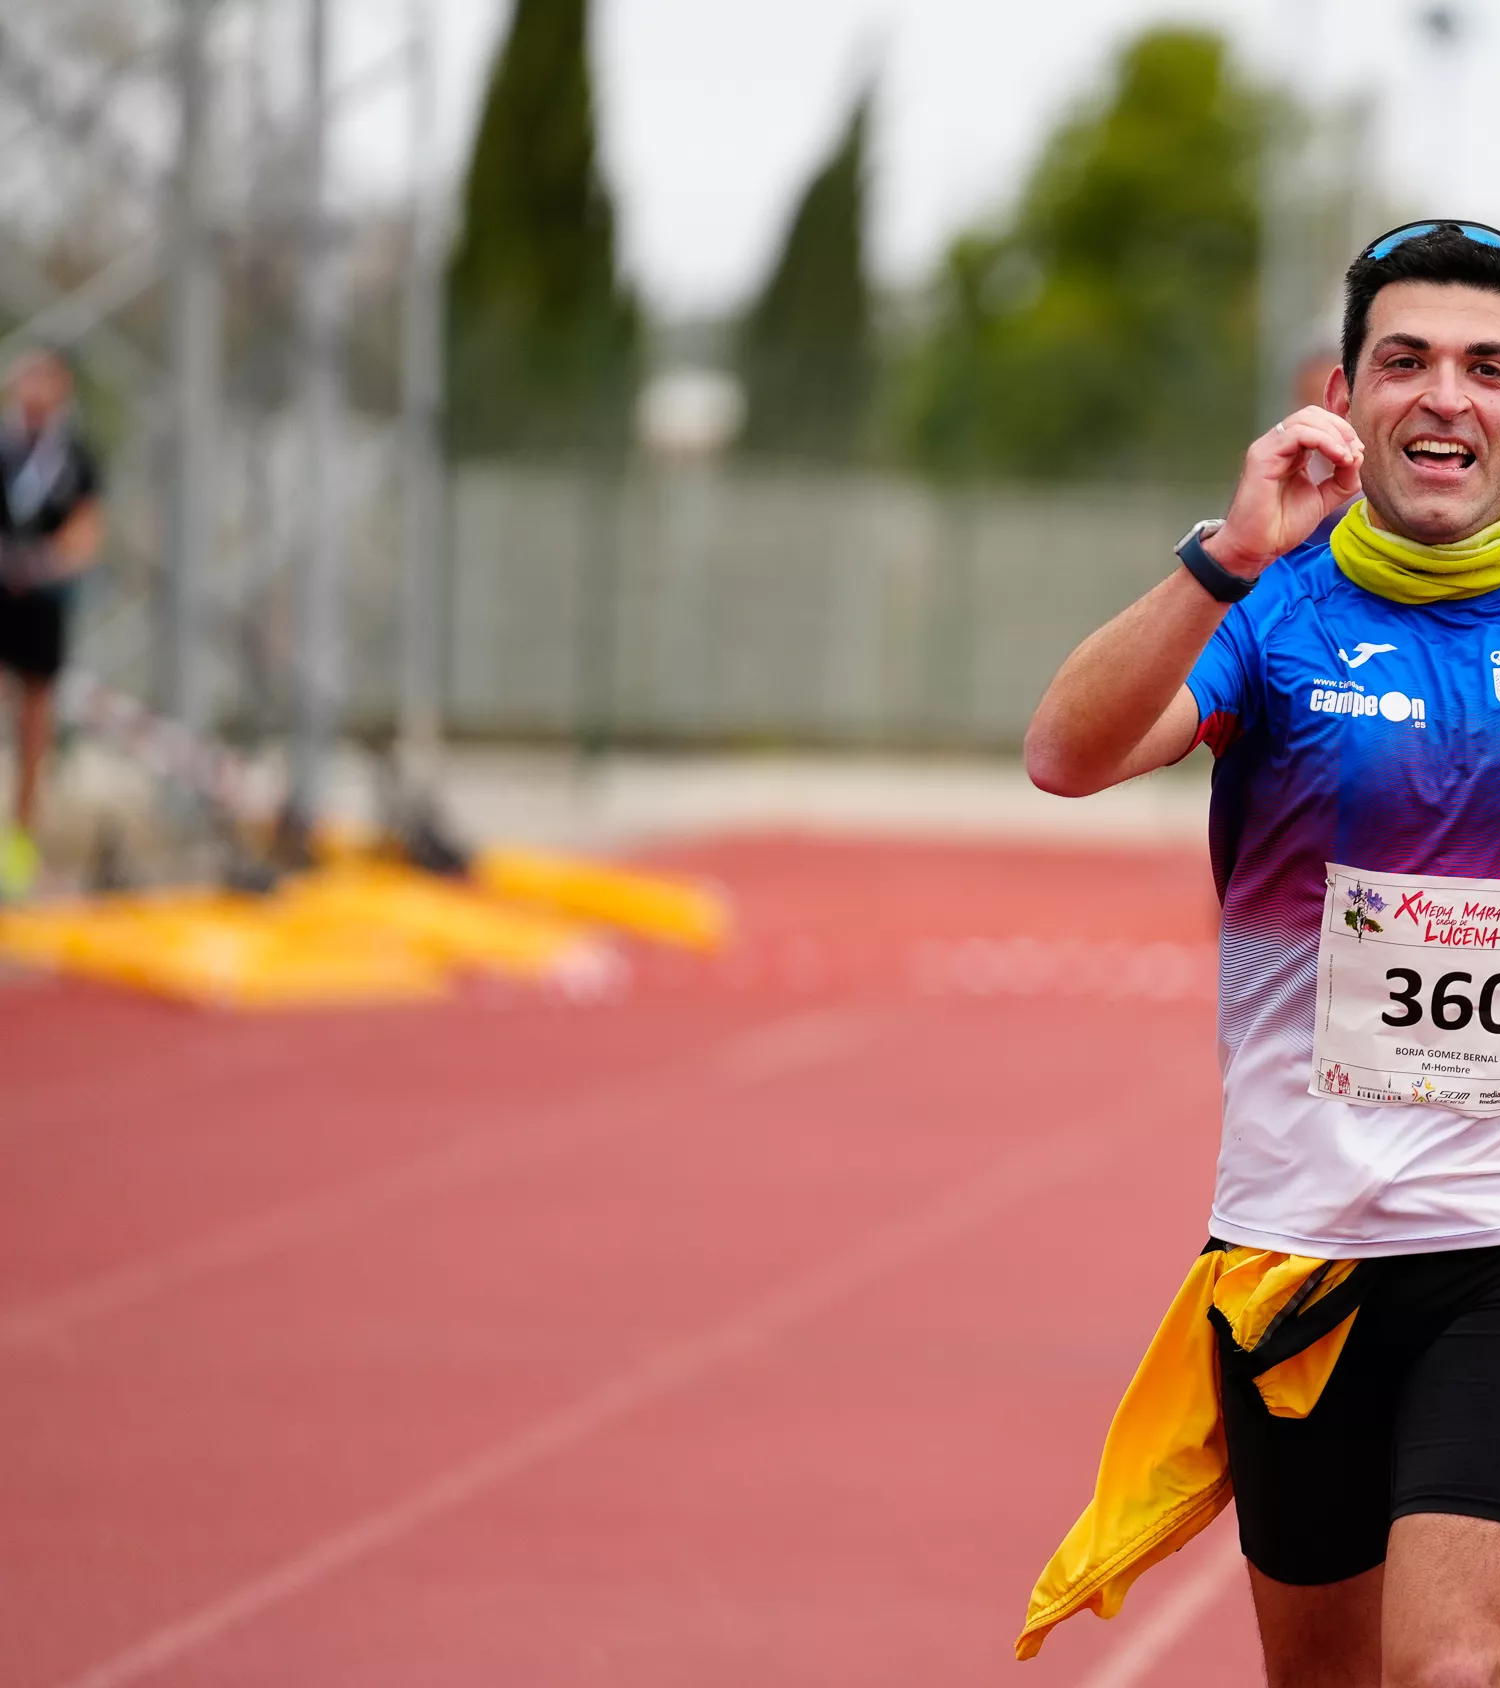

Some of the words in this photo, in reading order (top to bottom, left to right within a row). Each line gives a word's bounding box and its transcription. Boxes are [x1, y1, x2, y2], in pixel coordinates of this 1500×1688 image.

[1395, 1047, 1425, 1057] BORJA
[1427, 1049, 1461, 1060] GOMEZ
[1463, 1052, 1499, 1063] BERNAL
[1421, 1062, 1471, 1074] M-Hombre
